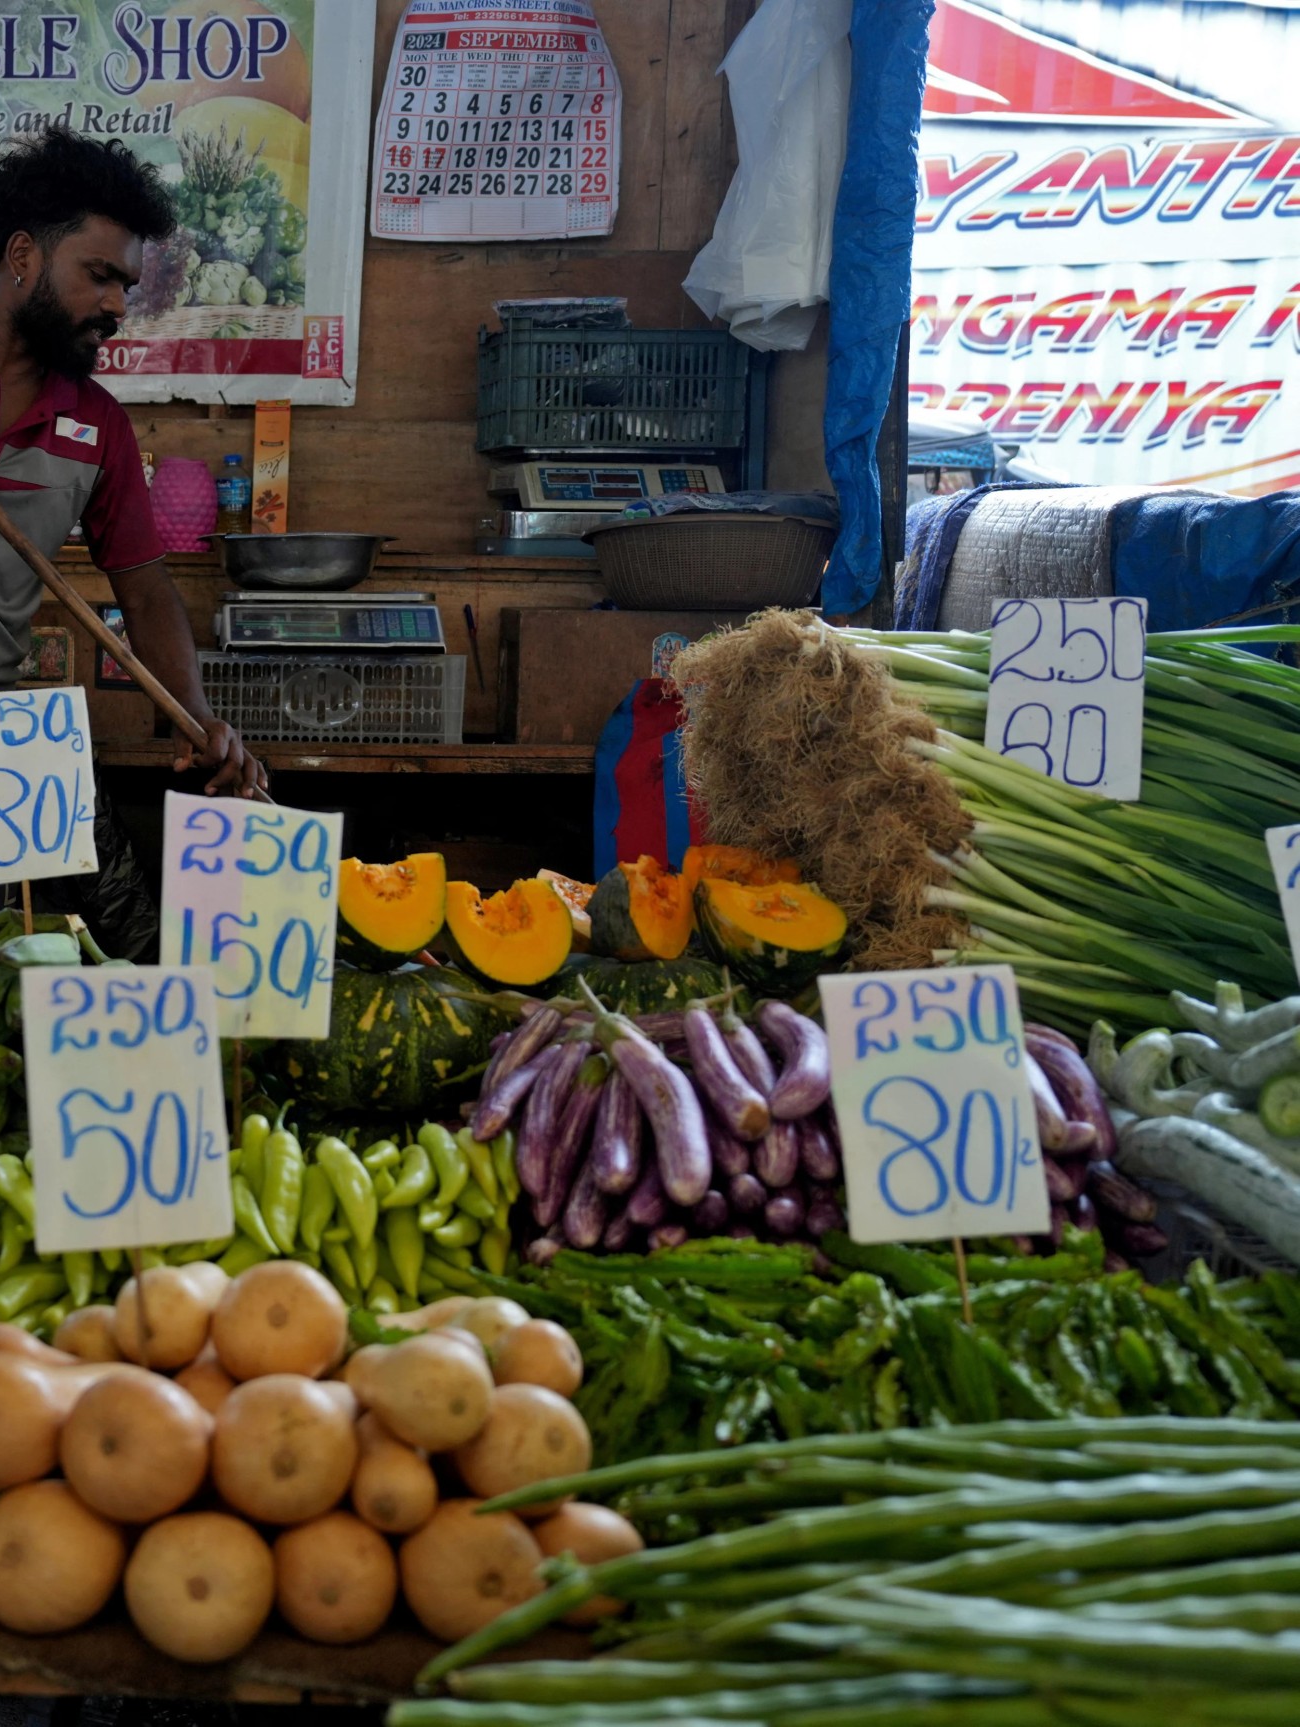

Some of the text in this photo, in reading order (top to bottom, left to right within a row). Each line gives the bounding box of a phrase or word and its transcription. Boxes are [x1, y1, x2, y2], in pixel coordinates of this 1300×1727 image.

[439, 1, 467, 11] MAIN
[467, 0, 502, 9] CROSS
[453, 13, 469, 21] Tel:
[103, 1, 290, 96] SHOP
[406, 31, 598, 51] 2024 SEPTEMBER 9
[404, 53, 428, 62] MON
[437, 52, 458, 61] TUE
[467, 52, 492, 61] WED
[501, 52, 524, 62] THU
[536, 53, 554, 63] FRI
[567, 53, 584, 63] SAT
[400, 66, 427, 87] 30
[597, 66, 606, 88] 1
[401, 92, 604, 115] 2 3 4 5 6 7 8
[14, 101, 73, 133] and
[80, 101, 175, 134] Retail
[397, 117, 607, 142] 9 10 11 12 13 14 15
[389, 145, 607, 169] 16 17 18 19 20 21 22
[383, 172, 607, 196] 23 24 25 26 27 28 29
[990, 599, 1147, 683] 250
[1000, 702, 1107, 787] 80
[180, 808, 333, 898] 250g
